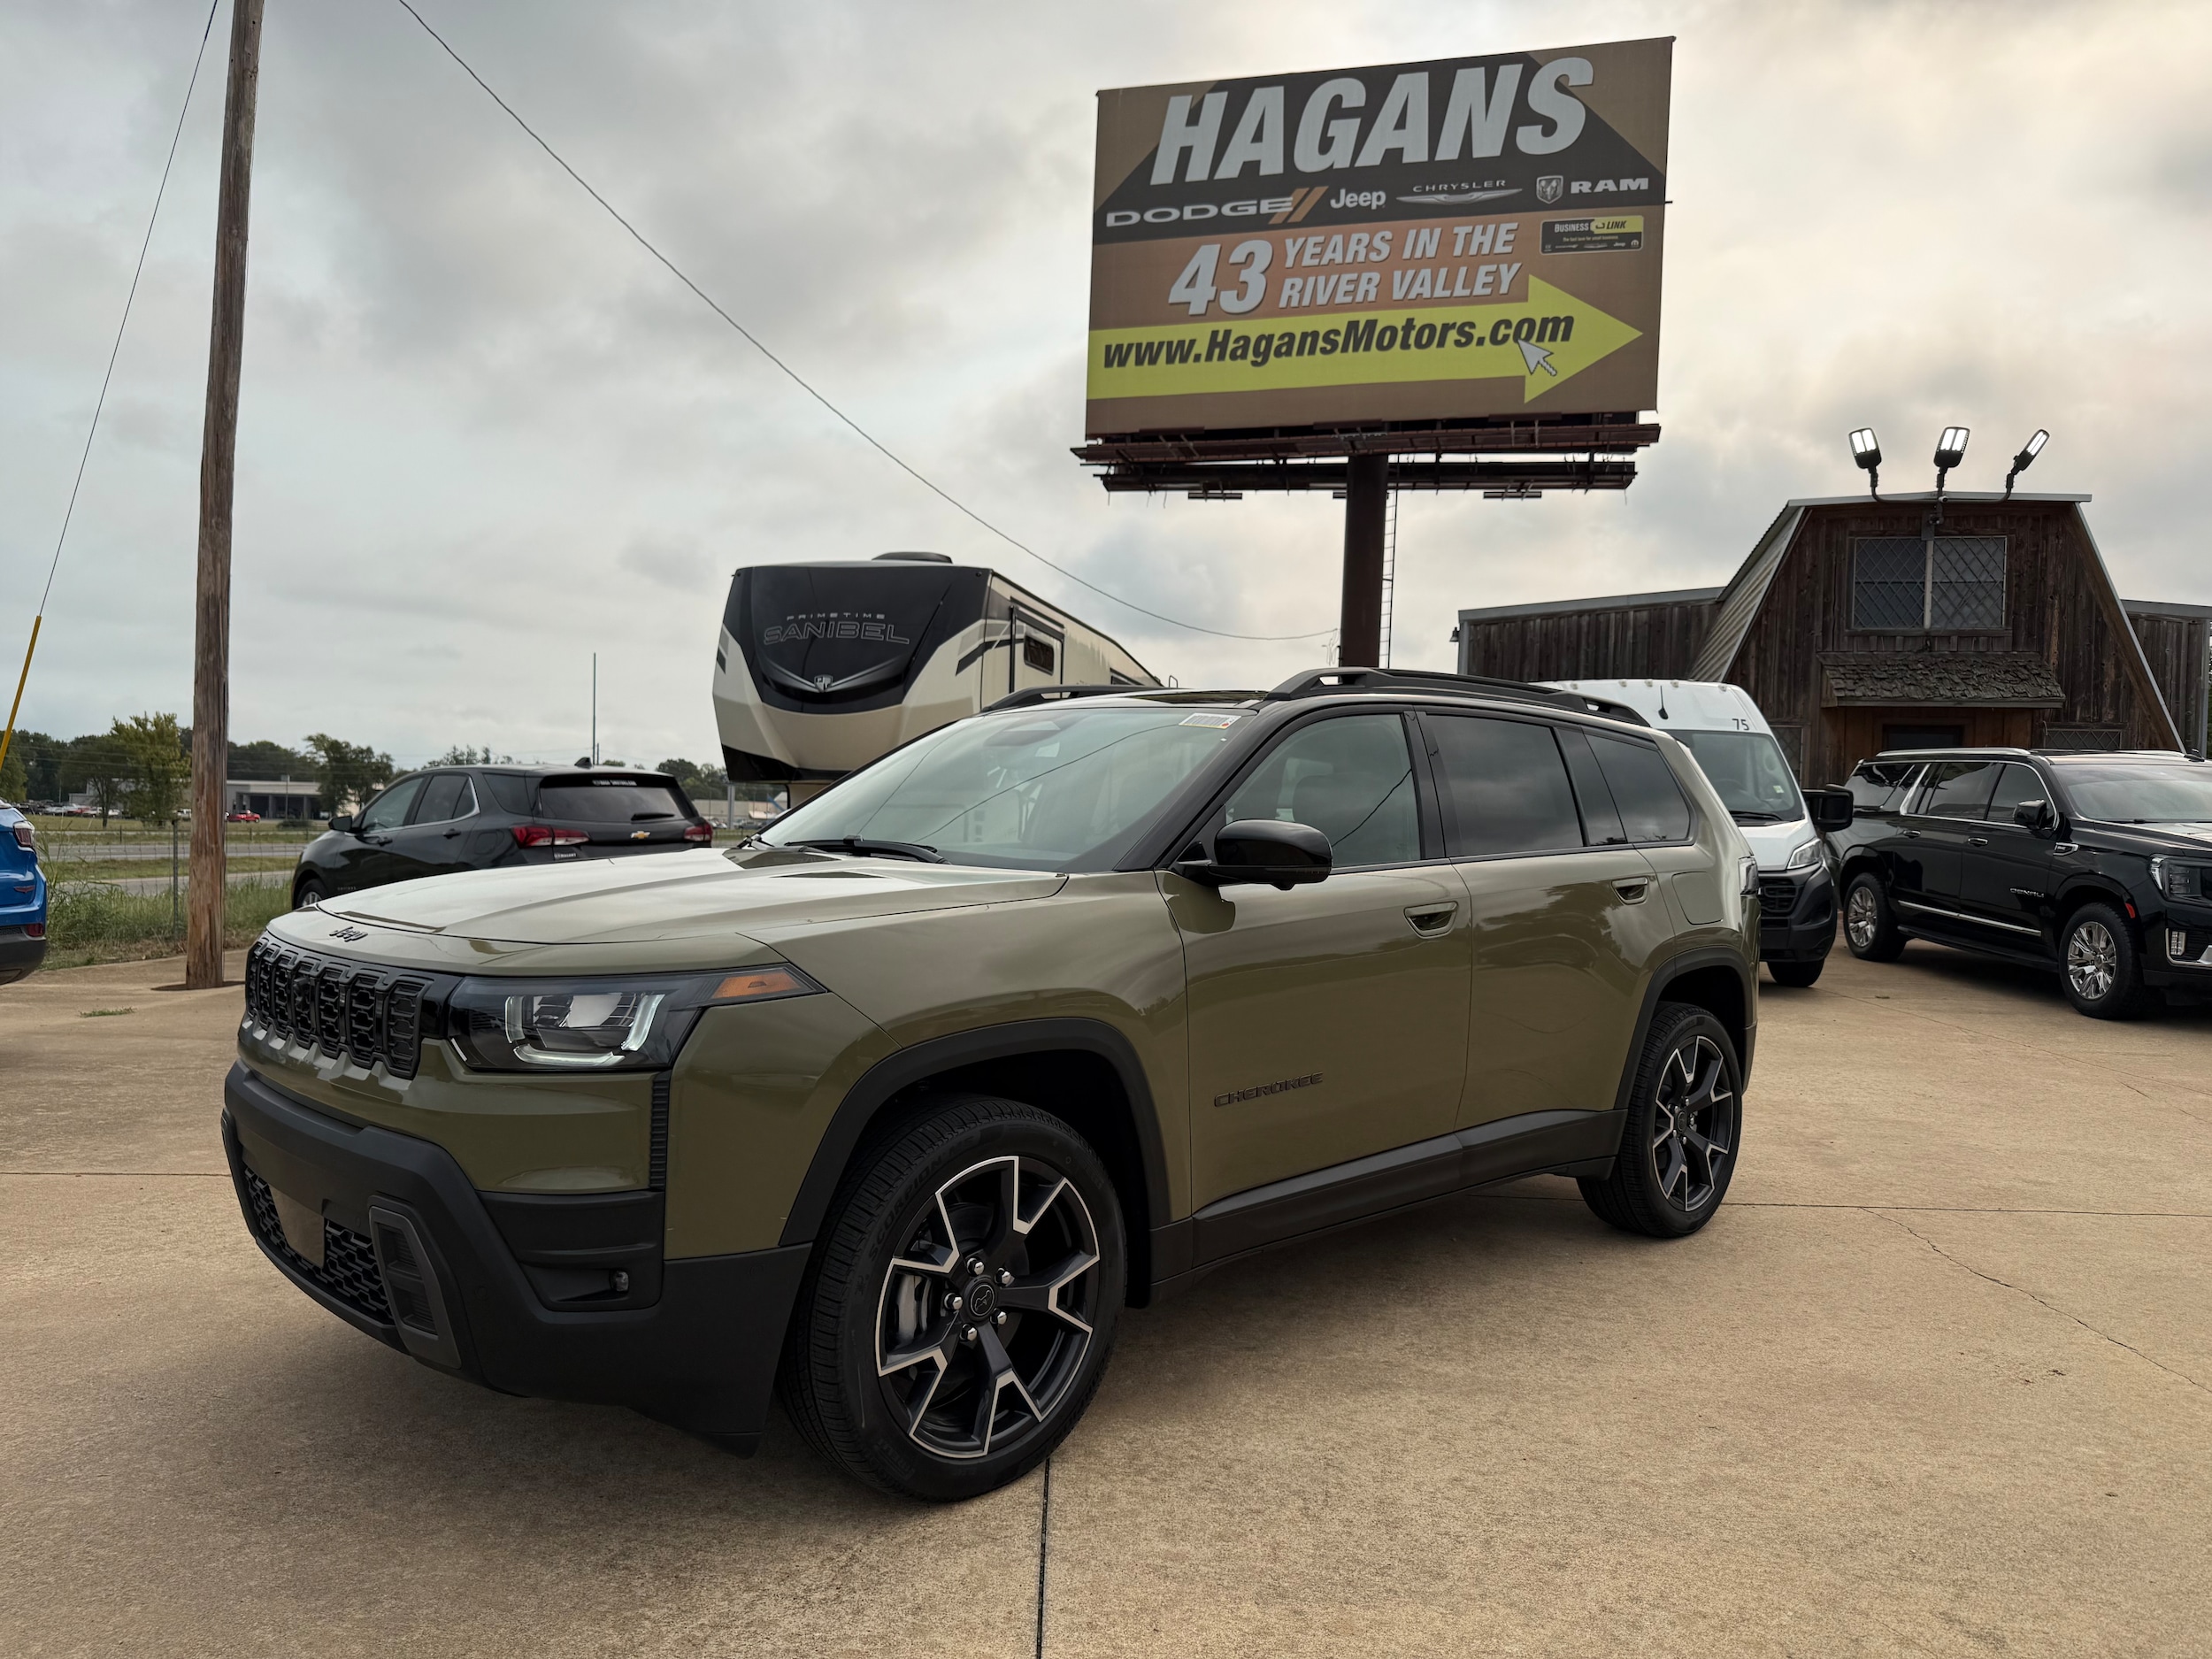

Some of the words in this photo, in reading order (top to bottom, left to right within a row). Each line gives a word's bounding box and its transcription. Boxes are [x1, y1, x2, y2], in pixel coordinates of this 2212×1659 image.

[1150, 57, 1594, 186] HAGANS
[1106, 196, 1294, 227] DODGE
[1330, 188, 1386, 210] Jeep
[1413, 180, 1507, 192] CHRYSLER
[1571, 177, 1649, 194] RAM
[1284, 230, 1394, 269] YEARS
[1402, 227, 1443, 260] IN
[1452, 222, 1519, 257] THE
[1555, 222, 1589, 233] BUSINESS
[1606, 220, 1626, 229] LINK
[1167, 239, 1274, 316] 43
[1279, 271, 1382, 309] RIVER
[1392, 262, 1523, 301] VALLEY
[1103, 315, 1575, 369] www.HagansMotors.com
[764, 621, 910, 646] SANIBEL
[1732, 718, 1749, 731] 75
[329, 926, 369, 942] Jeep
[1213, 1071, 1325, 1107] CHEROKEE
[869, 1153, 944, 1262] SCORPION
